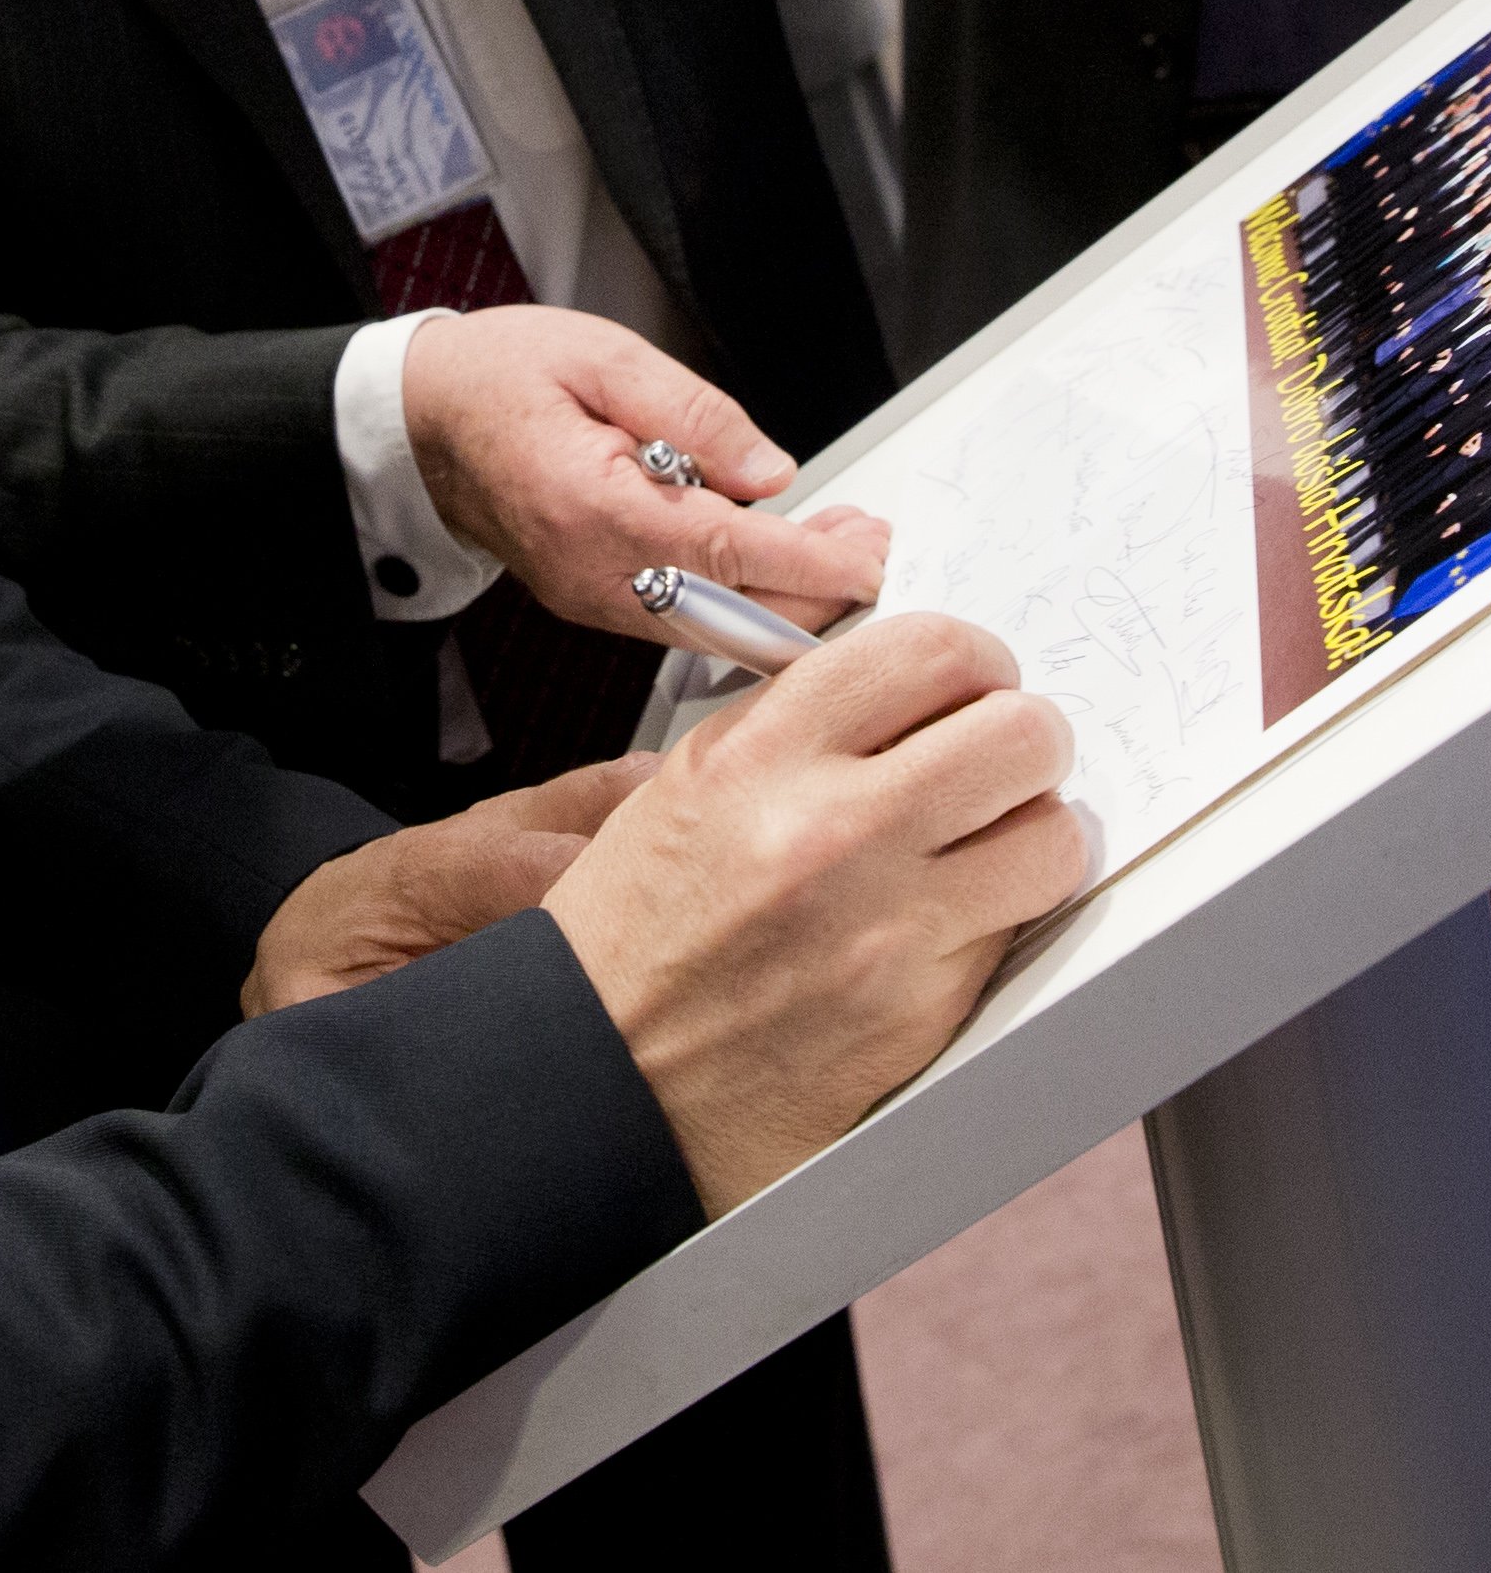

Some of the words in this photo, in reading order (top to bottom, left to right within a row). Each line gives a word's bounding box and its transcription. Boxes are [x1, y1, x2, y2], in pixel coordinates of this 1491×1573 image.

[1244, 191, 1301, 289] Welcome
[1257, 270, 1322, 370] Croatia!
[1276, 352, 1344, 444] Dobro
[1292, 427, 1365, 518] došla
[1302, 496, 1396, 672] Hrvatska!
